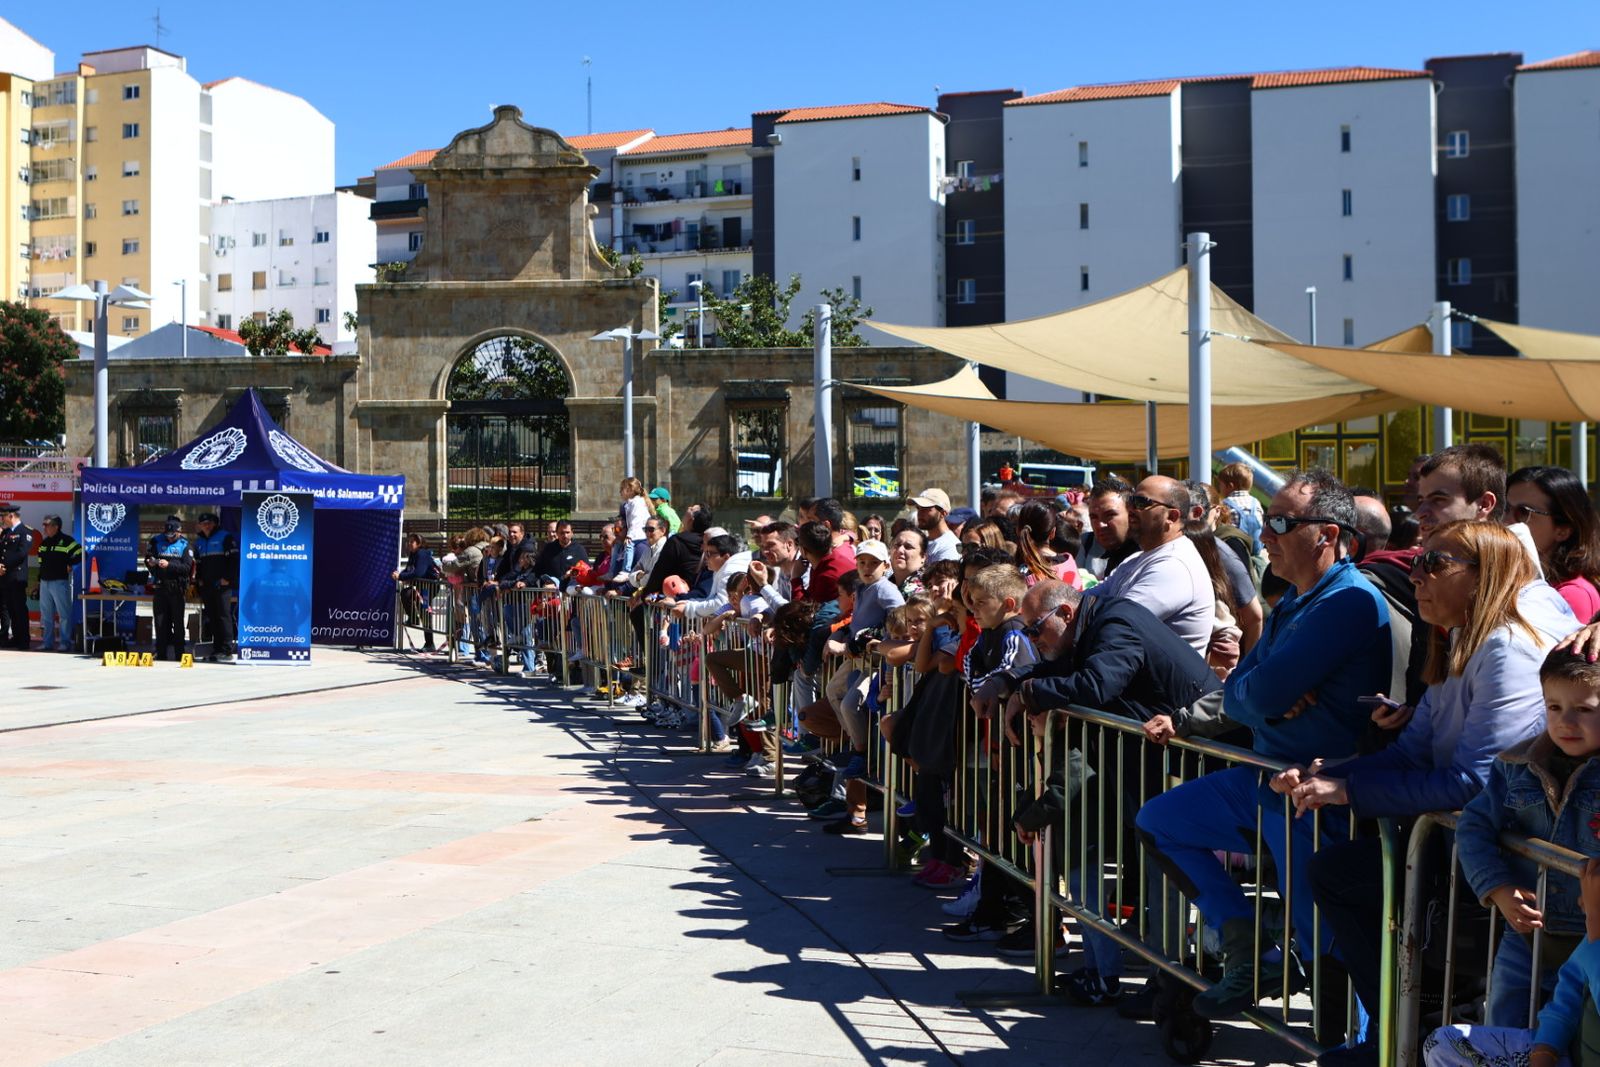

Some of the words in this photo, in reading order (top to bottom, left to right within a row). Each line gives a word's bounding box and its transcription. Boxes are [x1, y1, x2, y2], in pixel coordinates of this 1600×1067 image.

[83, 482, 117, 494] Policía
[120, 483, 147, 494] Local
[150, 484, 163, 495] de
[166, 484, 225, 496] Salamanca
[326, 487, 336, 498] de
[337, 488, 374, 499] Salamanca
[84, 535, 108, 543] olicía
[250, 542, 279, 551] Policía
[282, 543, 305, 551] Local
[260, 552, 308, 560] Salamanca
[328, 607, 390, 622] Vocación
[243, 624, 284, 633] Vocación
[311, 625, 390, 639] ompromiso
[241, 636, 247, 644] y
[249, 634, 307, 644] compromiso
[118, 653, 124, 663] 8
[130, 654, 136, 664] 7
[142, 654, 148, 664] 6
[184, 655, 189, 665] 5
